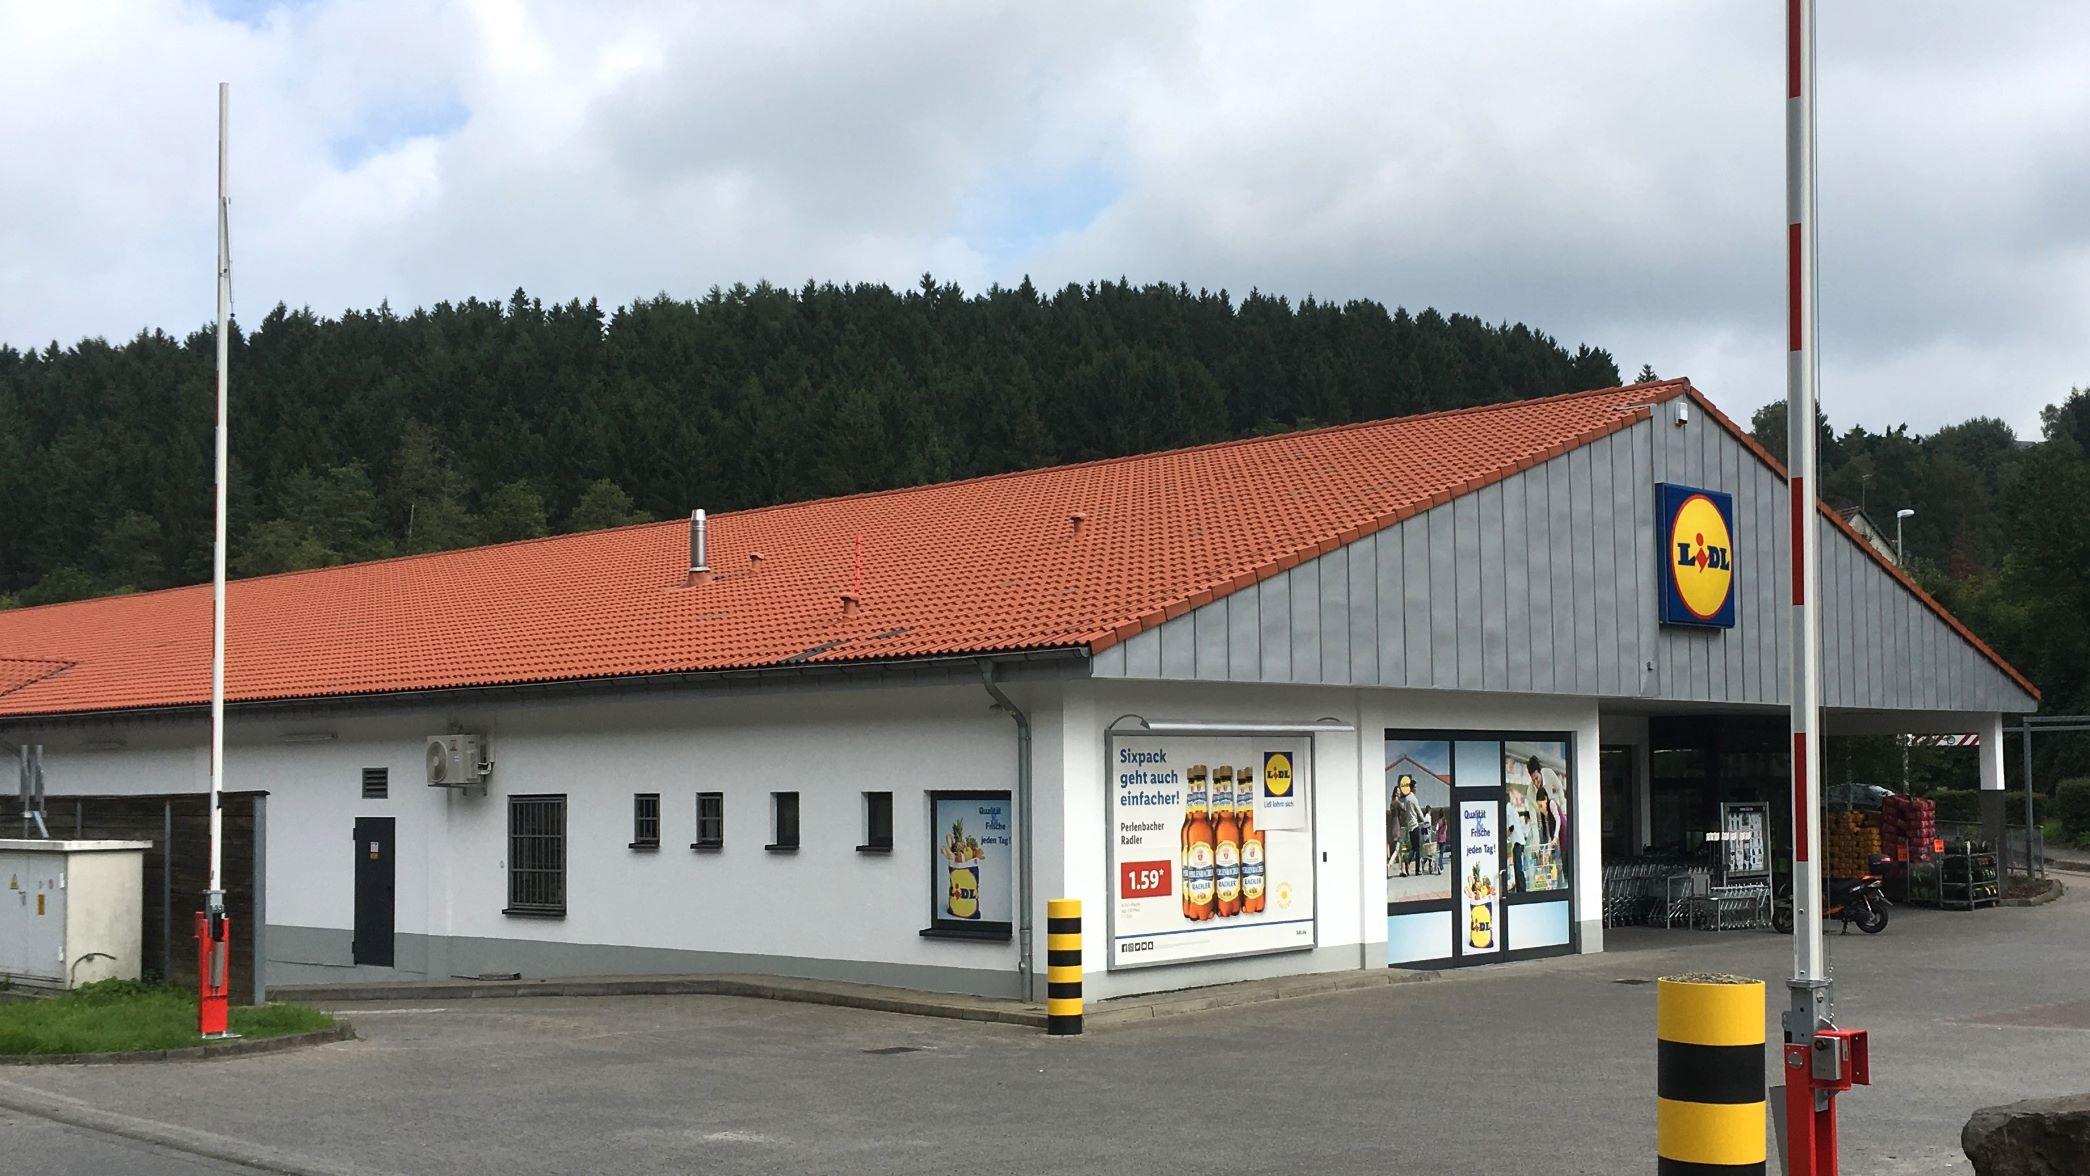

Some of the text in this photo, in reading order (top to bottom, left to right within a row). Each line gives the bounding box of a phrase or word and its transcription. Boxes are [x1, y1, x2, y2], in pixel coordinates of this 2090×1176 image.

[1677, 533, 1730, 573] LIDL
[1120, 748, 1167, 766] Sixpack
[1120, 770, 1178, 788] geht auch
[1120, 791, 1179, 805] einfacher!
[1464, 810, 1486, 819] Qualität
[1121, 822, 1164, 832] Perlenbacher
[1121, 835, 1142, 845] Radler
[1467, 845, 1482, 856] jeden
